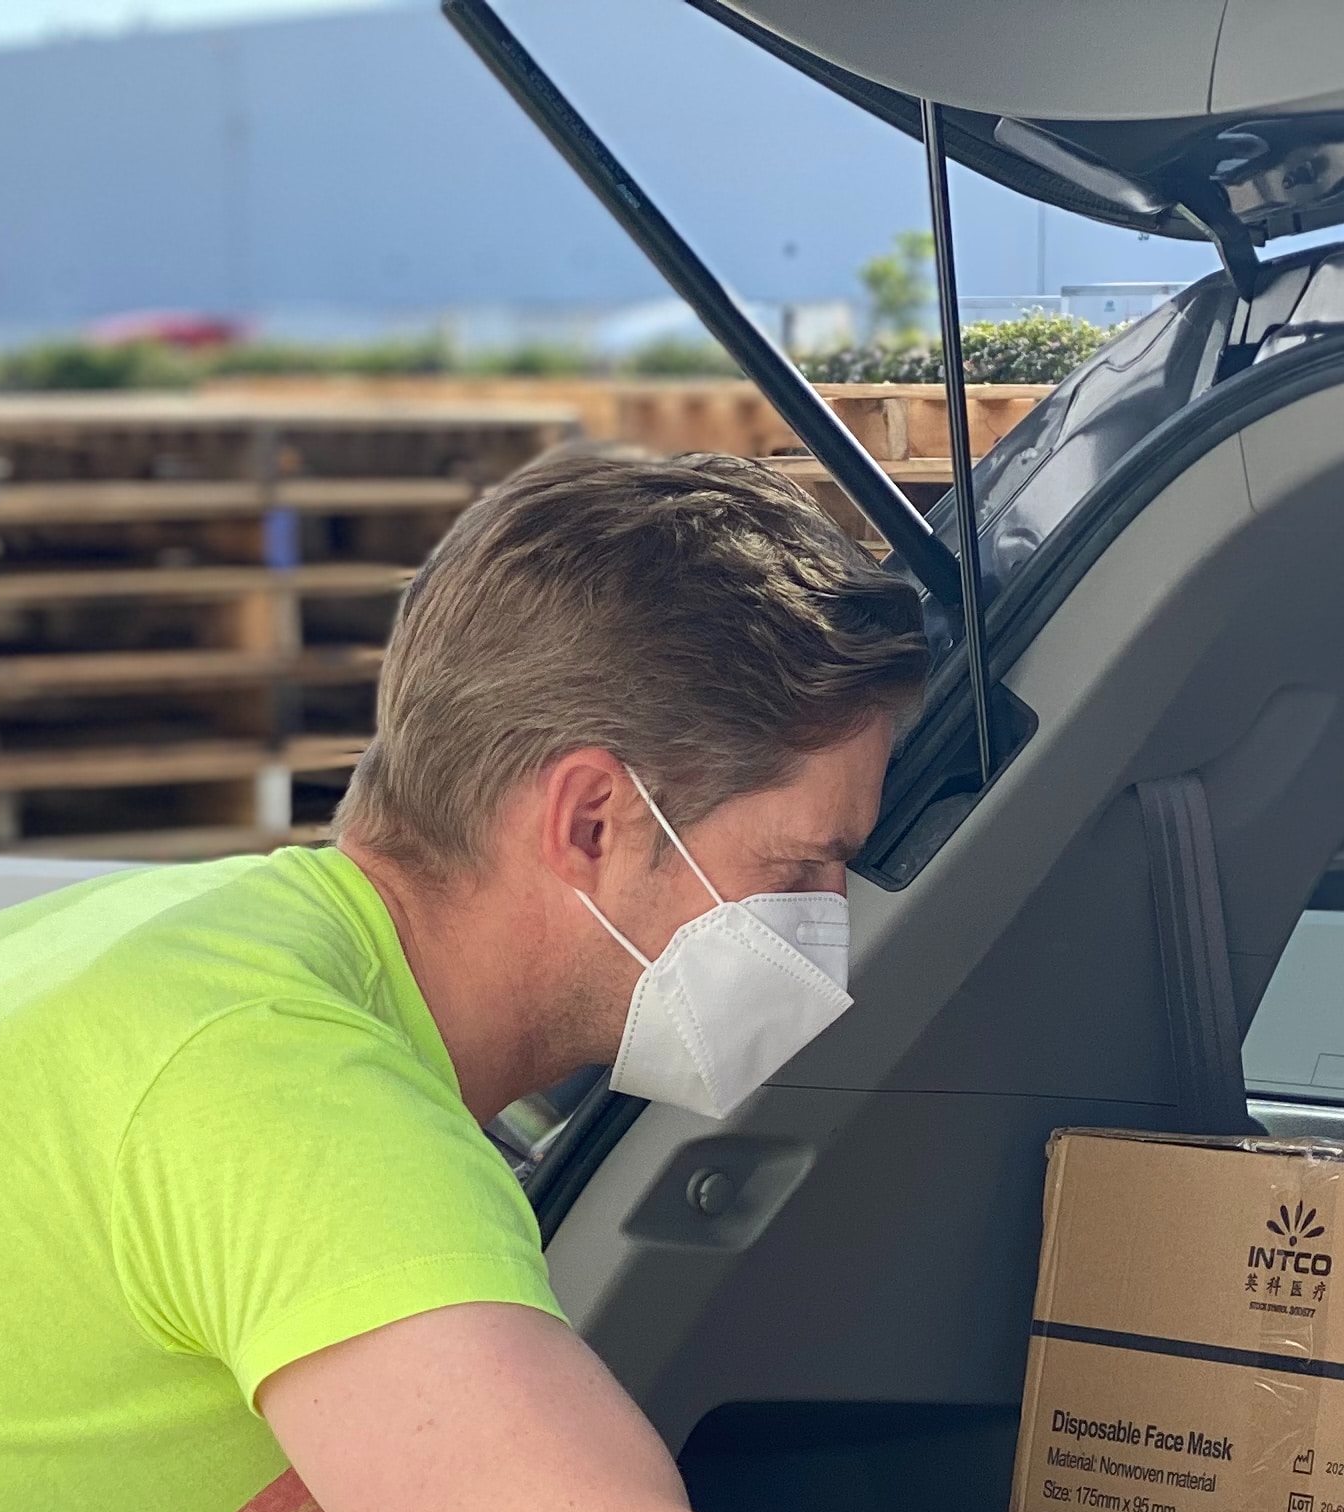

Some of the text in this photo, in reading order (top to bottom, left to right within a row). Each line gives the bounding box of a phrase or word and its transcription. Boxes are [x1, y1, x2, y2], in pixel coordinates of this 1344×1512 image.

[1247, 1245, 1332, 1277] INTCO
[1244, 1272, 1326, 1303] 英科医疗
[1051, 1409, 1234, 1461] Disposable Face Mask
[1046, 1445, 1216, 1492] Material: Nonwoven material
